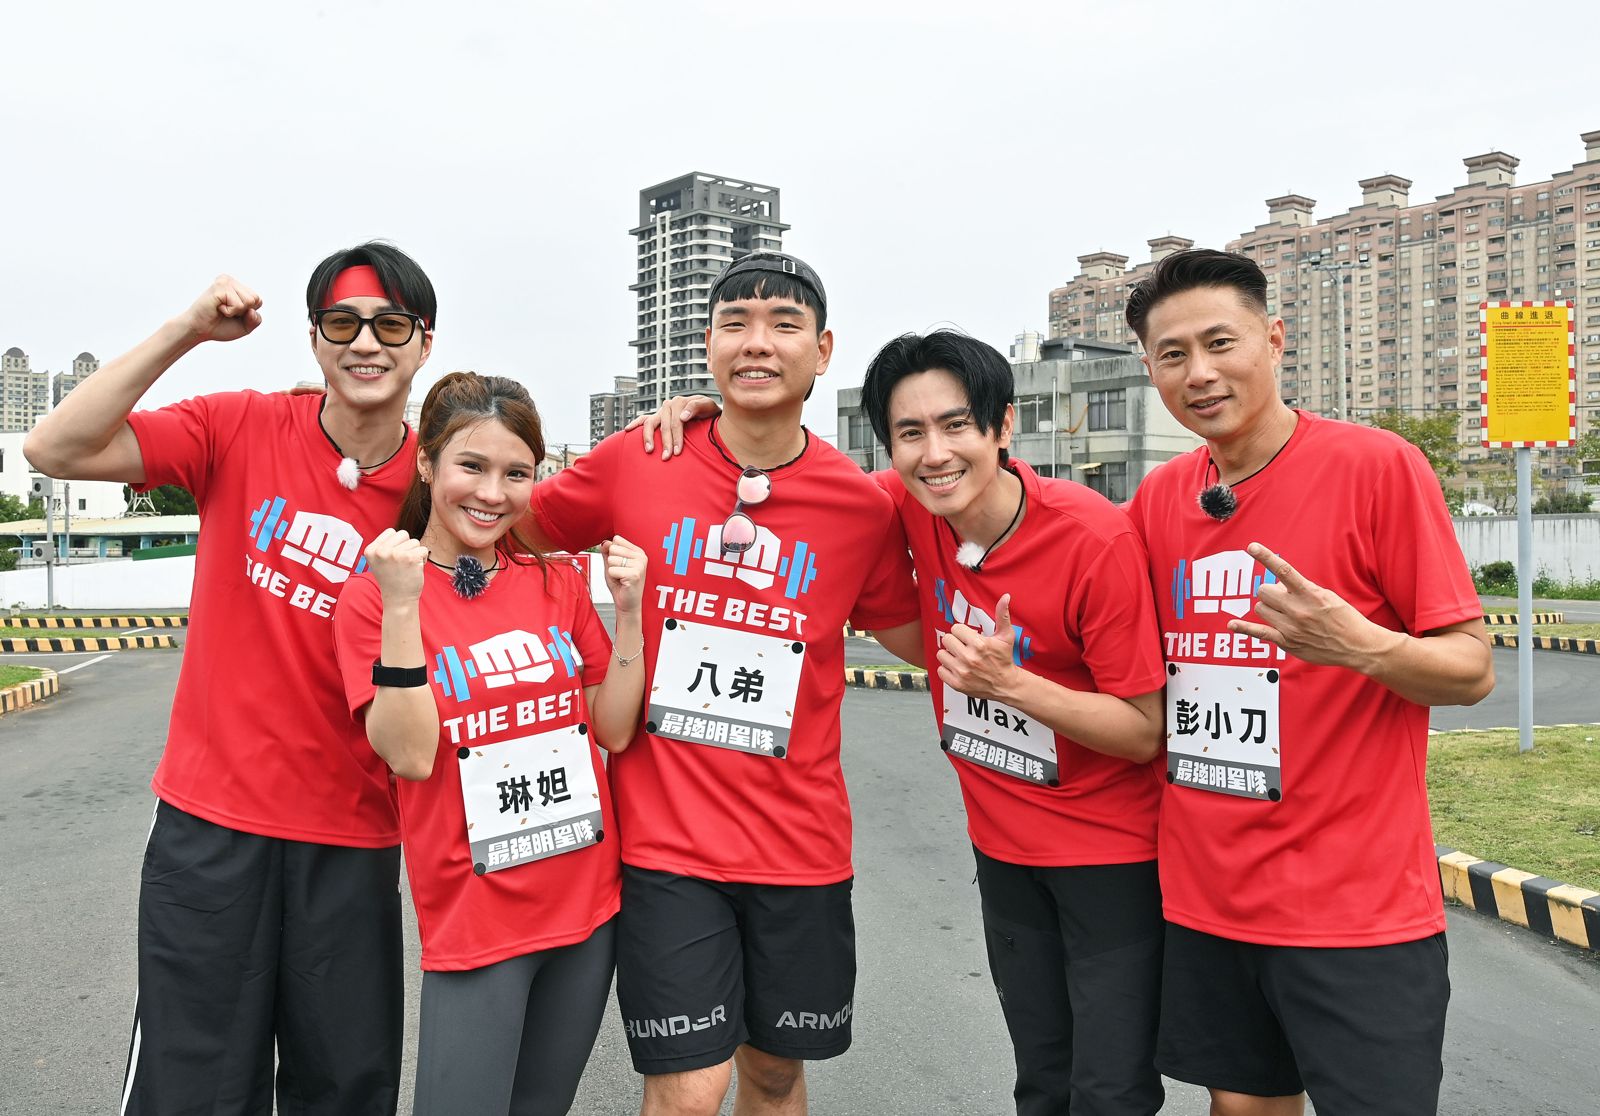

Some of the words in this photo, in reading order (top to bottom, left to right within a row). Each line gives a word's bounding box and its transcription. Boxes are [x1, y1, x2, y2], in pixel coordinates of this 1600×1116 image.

[1500, 310, 1554, 320] 曲線進退
[245, 553, 291, 598] THE
[289, 583, 337, 620] BE
[656, 585, 719, 618] THE
[722, 597, 808, 635] BEST
[1164, 632, 1209, 658] THE
[687, 661, 765, 704] 八弟
[443, 705, 509, 744] THE
[659, 712, 774, 751] 最強明星隊
[967, 696, 1029, 737] Max
[1176, 698, 1267, 744] 彭小刀
[950, 732, 1044, 781] 最強明星隊
[1175, 758, 1268, 794] 最強明星隊
[496, 766, 572, 814] 琳妲
[487, 818, 595, 867] 最強明星隊
